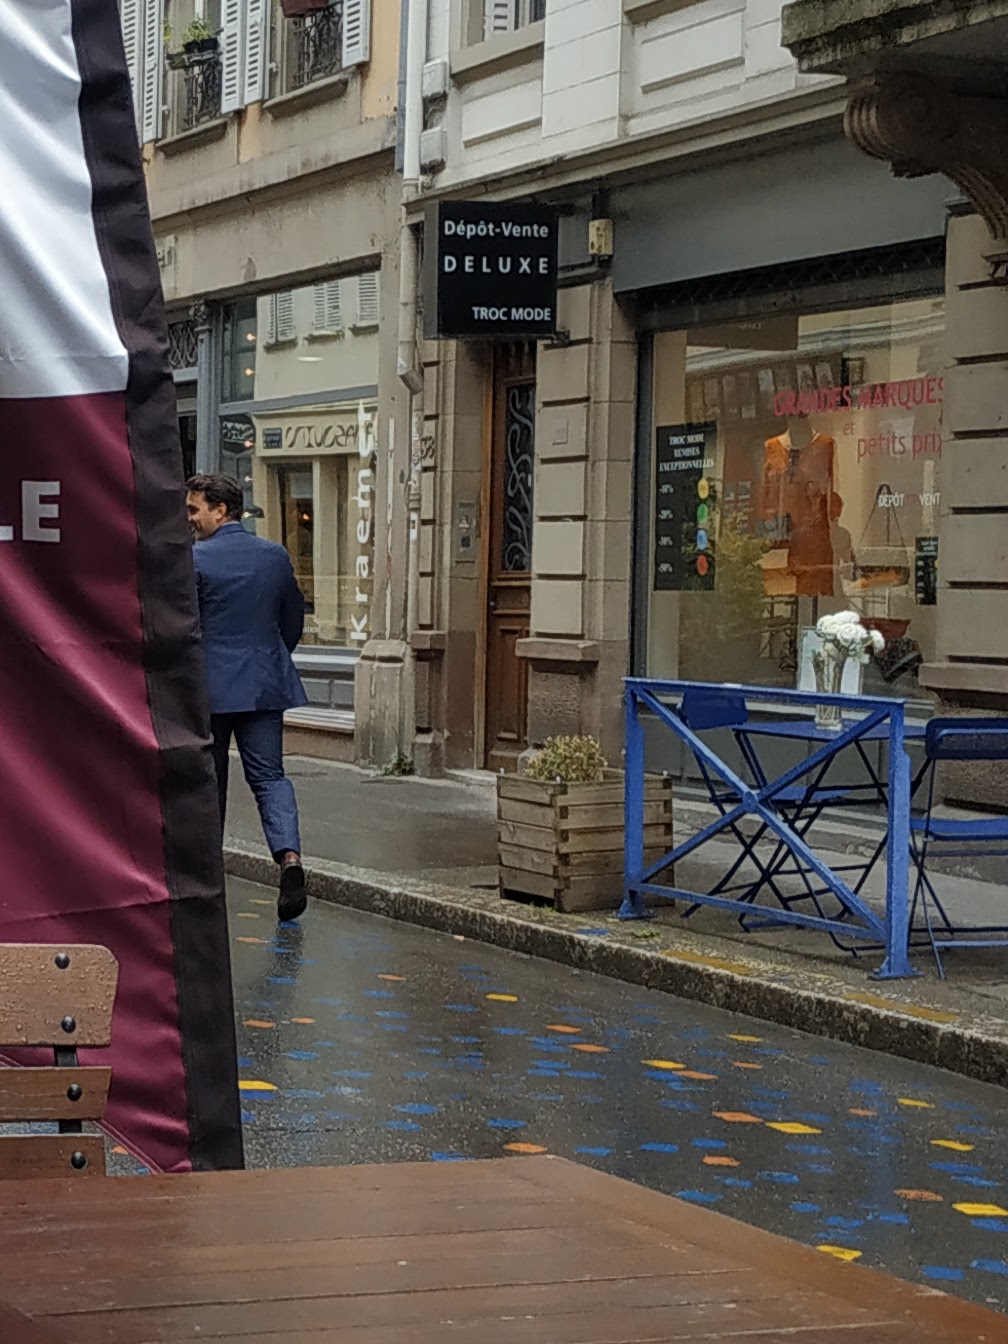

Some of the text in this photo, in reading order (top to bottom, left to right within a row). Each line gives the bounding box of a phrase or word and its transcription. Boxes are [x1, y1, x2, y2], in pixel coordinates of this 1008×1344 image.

[444, 219, 549, 239] Dépôt-Vente
[444, 255, 548, 274] DELUXE
[472, 306, 551, 321] TROC MODE
[774, 386, 852, 416] GRANDES
[669, 433, 705, 446] TROC MODE
[858, 429, 906, 464] petits
